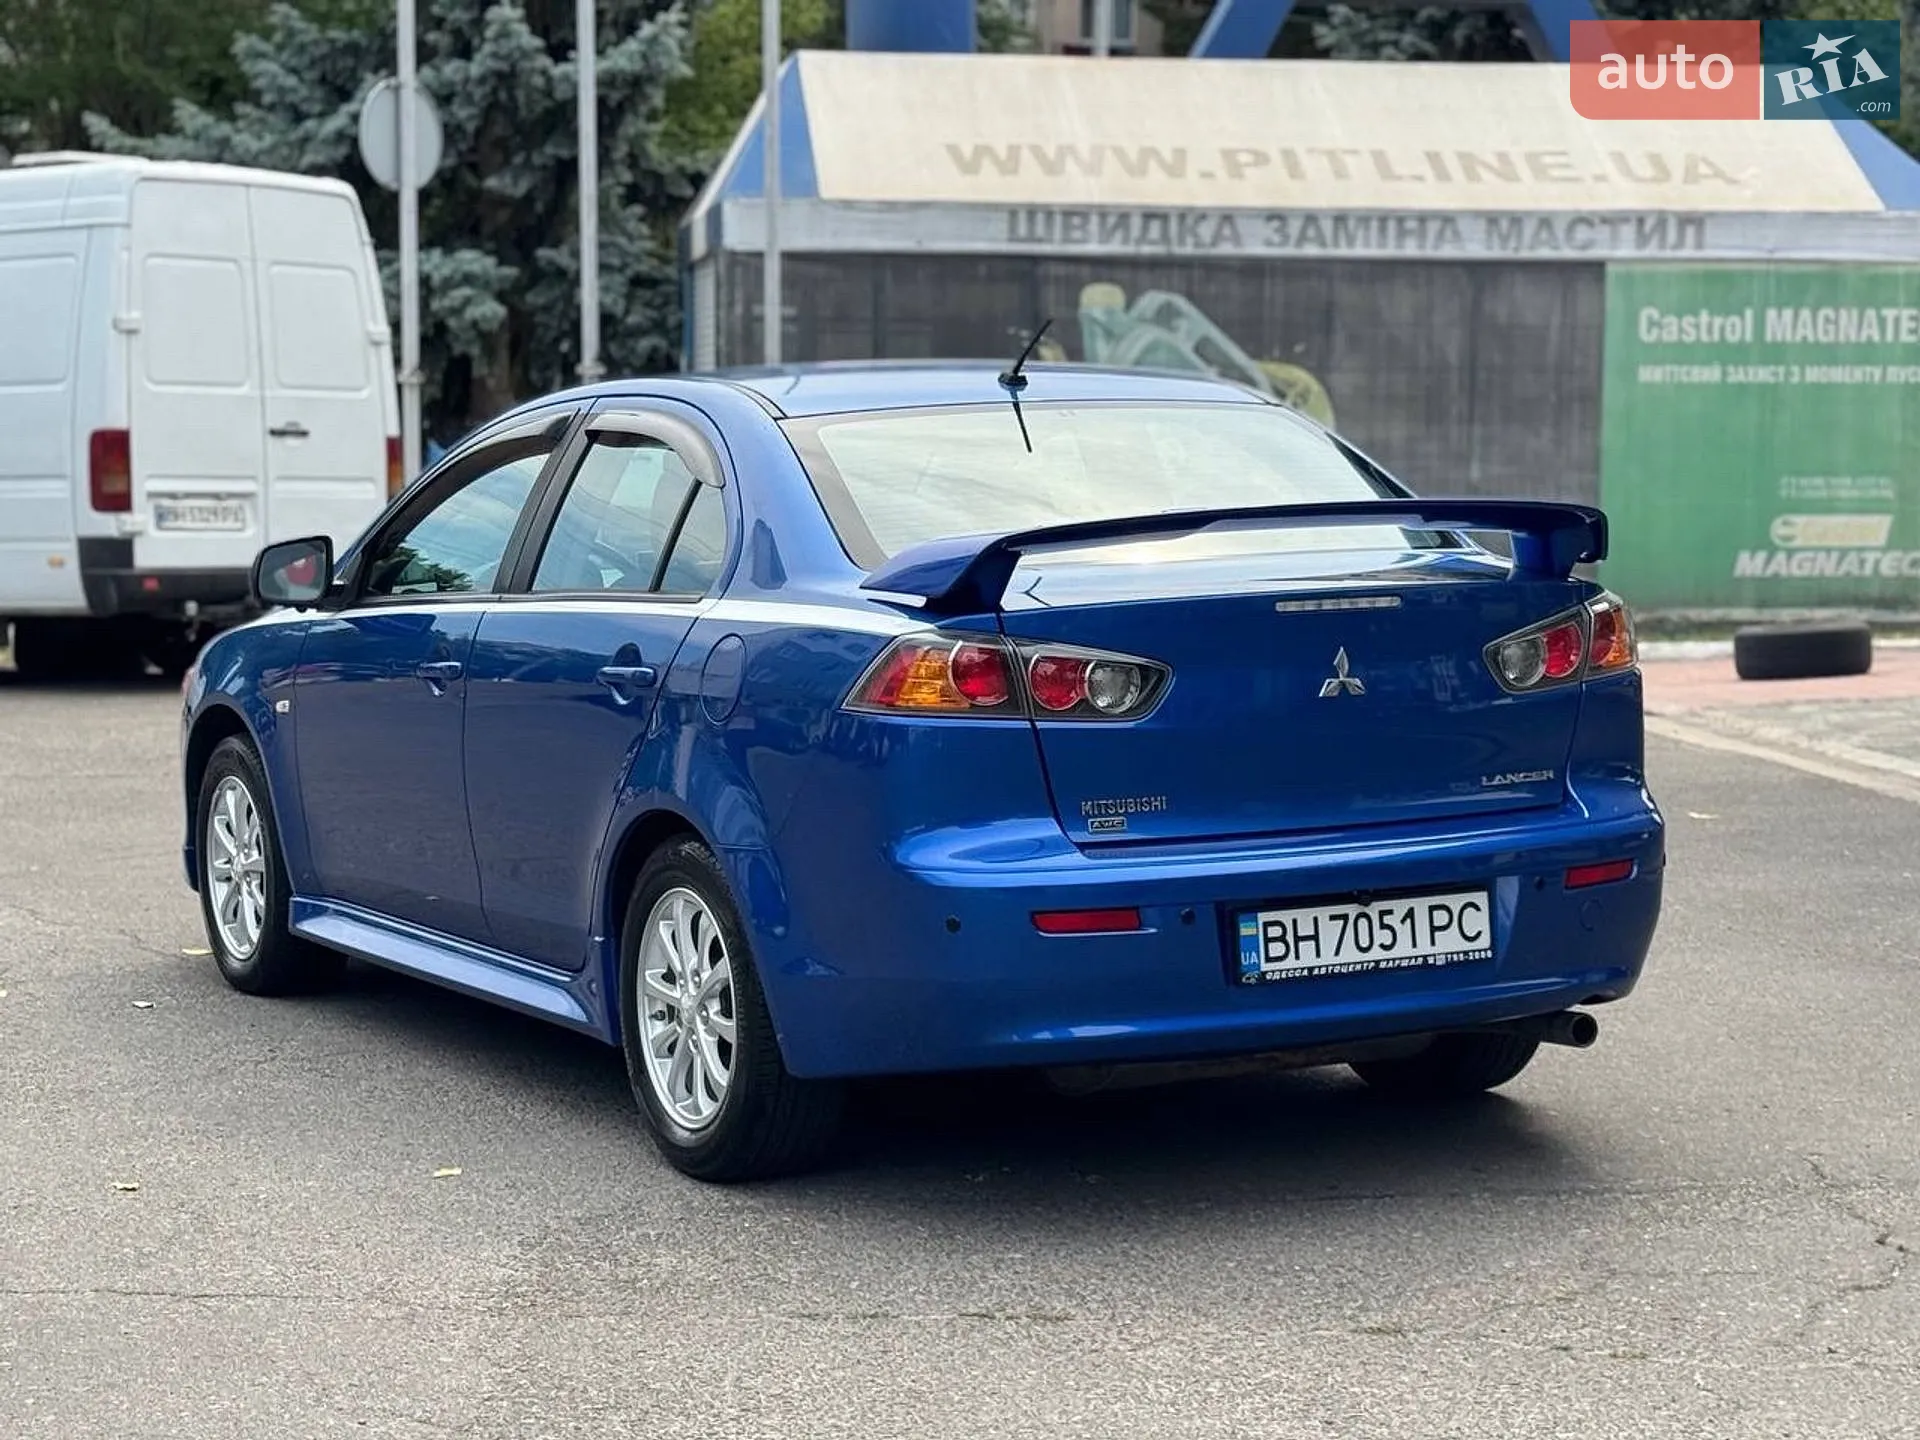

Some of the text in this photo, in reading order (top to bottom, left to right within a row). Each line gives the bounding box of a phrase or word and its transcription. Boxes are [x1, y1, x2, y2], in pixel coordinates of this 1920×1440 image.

[945, 142, 1741, 186] WWW.PITLINE.UA
[1007, 208, 1706, 253] ШВИДКА ЗАМІНА МАСТИЛ
[1637, 306, 1754, 343] Castrol
[1481, 769, 1554, 786] LANCER
[1081, 796, 1167, 816] MITSUBISHI
[1240, 951, 1259, 966] UA
[1265, 966, 1309, 981] ОДЕССА
